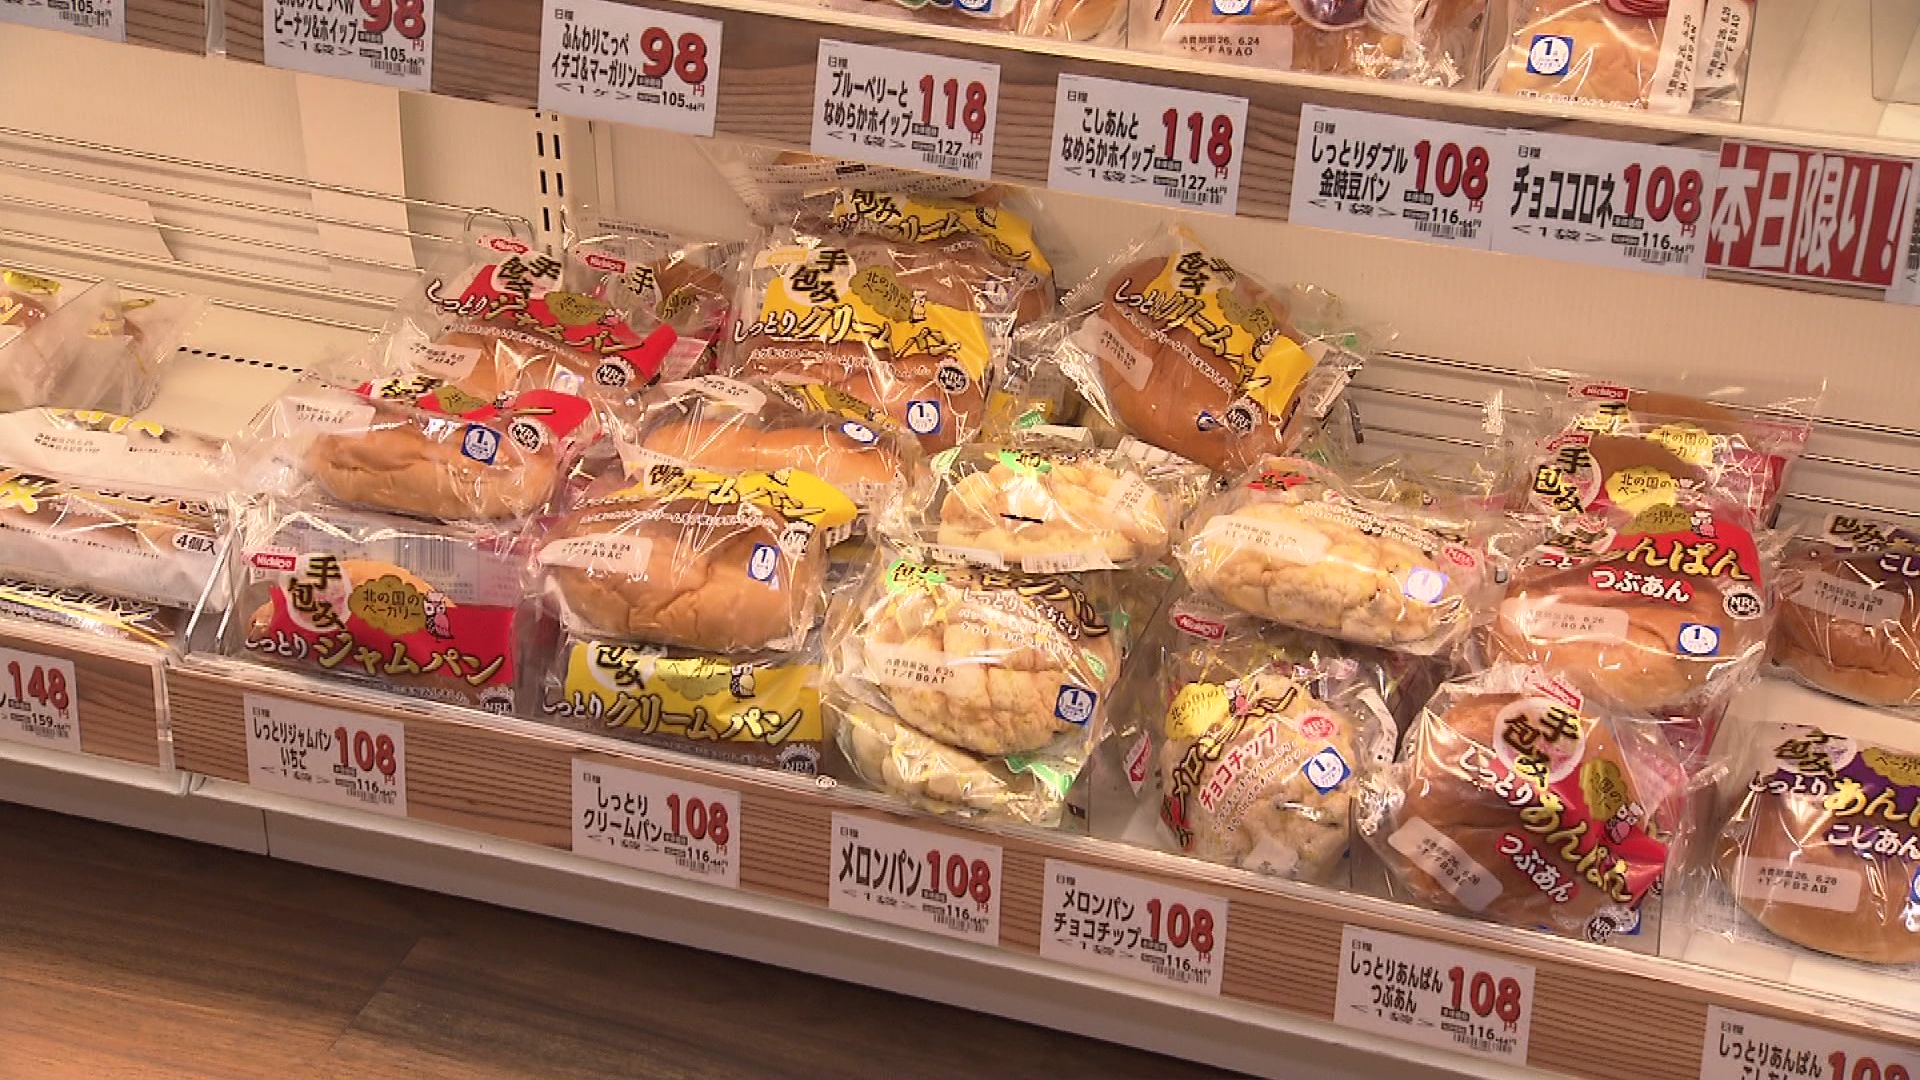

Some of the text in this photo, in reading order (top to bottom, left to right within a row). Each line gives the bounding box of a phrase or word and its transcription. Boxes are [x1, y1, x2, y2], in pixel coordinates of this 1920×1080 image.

[361, 0, 426, 39] 98
[562, 23, 630, 56] ふんわりこっぺ
[552, 52, 637, 88] イチゴ&マーガリン
[640, 26, 708, 84] 98
[832, 71, 909, 107] ブルーベリーと
[919, 75, 987, 132] 118
[824, 99, 913, 137] なめらかホイップ
[1082, 107, 1139, 139] こしあんと
[1162, 108, 1233, 167] 118
[1062, 133, 1156, 171] なめらかホイップ
[1311, 135, 1409, 174] しっとりダブル
[1414, 139, 1490, 200] 108
[1319, 167, 1391, 203] 金時豆パン
[1510, 165, 1615, 229] チョココロネ
[1623, 163, 1703, 224] 108
[791, 248, 849, 303] 手包み
[1534, 448, 1592, 513] 手包み
[174, 534, 217, 556] 4個入
[287, 555, 346, 630] 手包み
[363, 588, 420, 606] 北の国の
[1592, 569, 1690, 602] つぶあん
[7, 660, 69, 709] 148
[254, 717, 332, 751] しっとりジャムパン
[334, 726, 396, 776] 108
[280, 747, 307, 769] いちご
[1200, 724, 1277, 810] チョコチップ
[598, 786, 648, 817] しっとり
[666, 792, 730, 845] 108
[583, 809, 663, 842] クリームパン
[1827, 823, 1920, 860] こしあん
[839, 841, 922, 897] メロンパン
[926, 849, 991, 903] 108
[1500, 834, 1575, 902] つぶあん
[1062, 889, 1135, 921] メロンパン
[1147, 898, 1214, 953] 108
[1054, 912, 1142, 949] チョコチップ
[1350, 951, 1443, 994] しっとりあんぱん
[1371, 983, 1417, 1014] つぶあん
[1448, 966, 1522, 1023] 108
[1719, 1033, 1822, 1078] しっとりあんぱん
